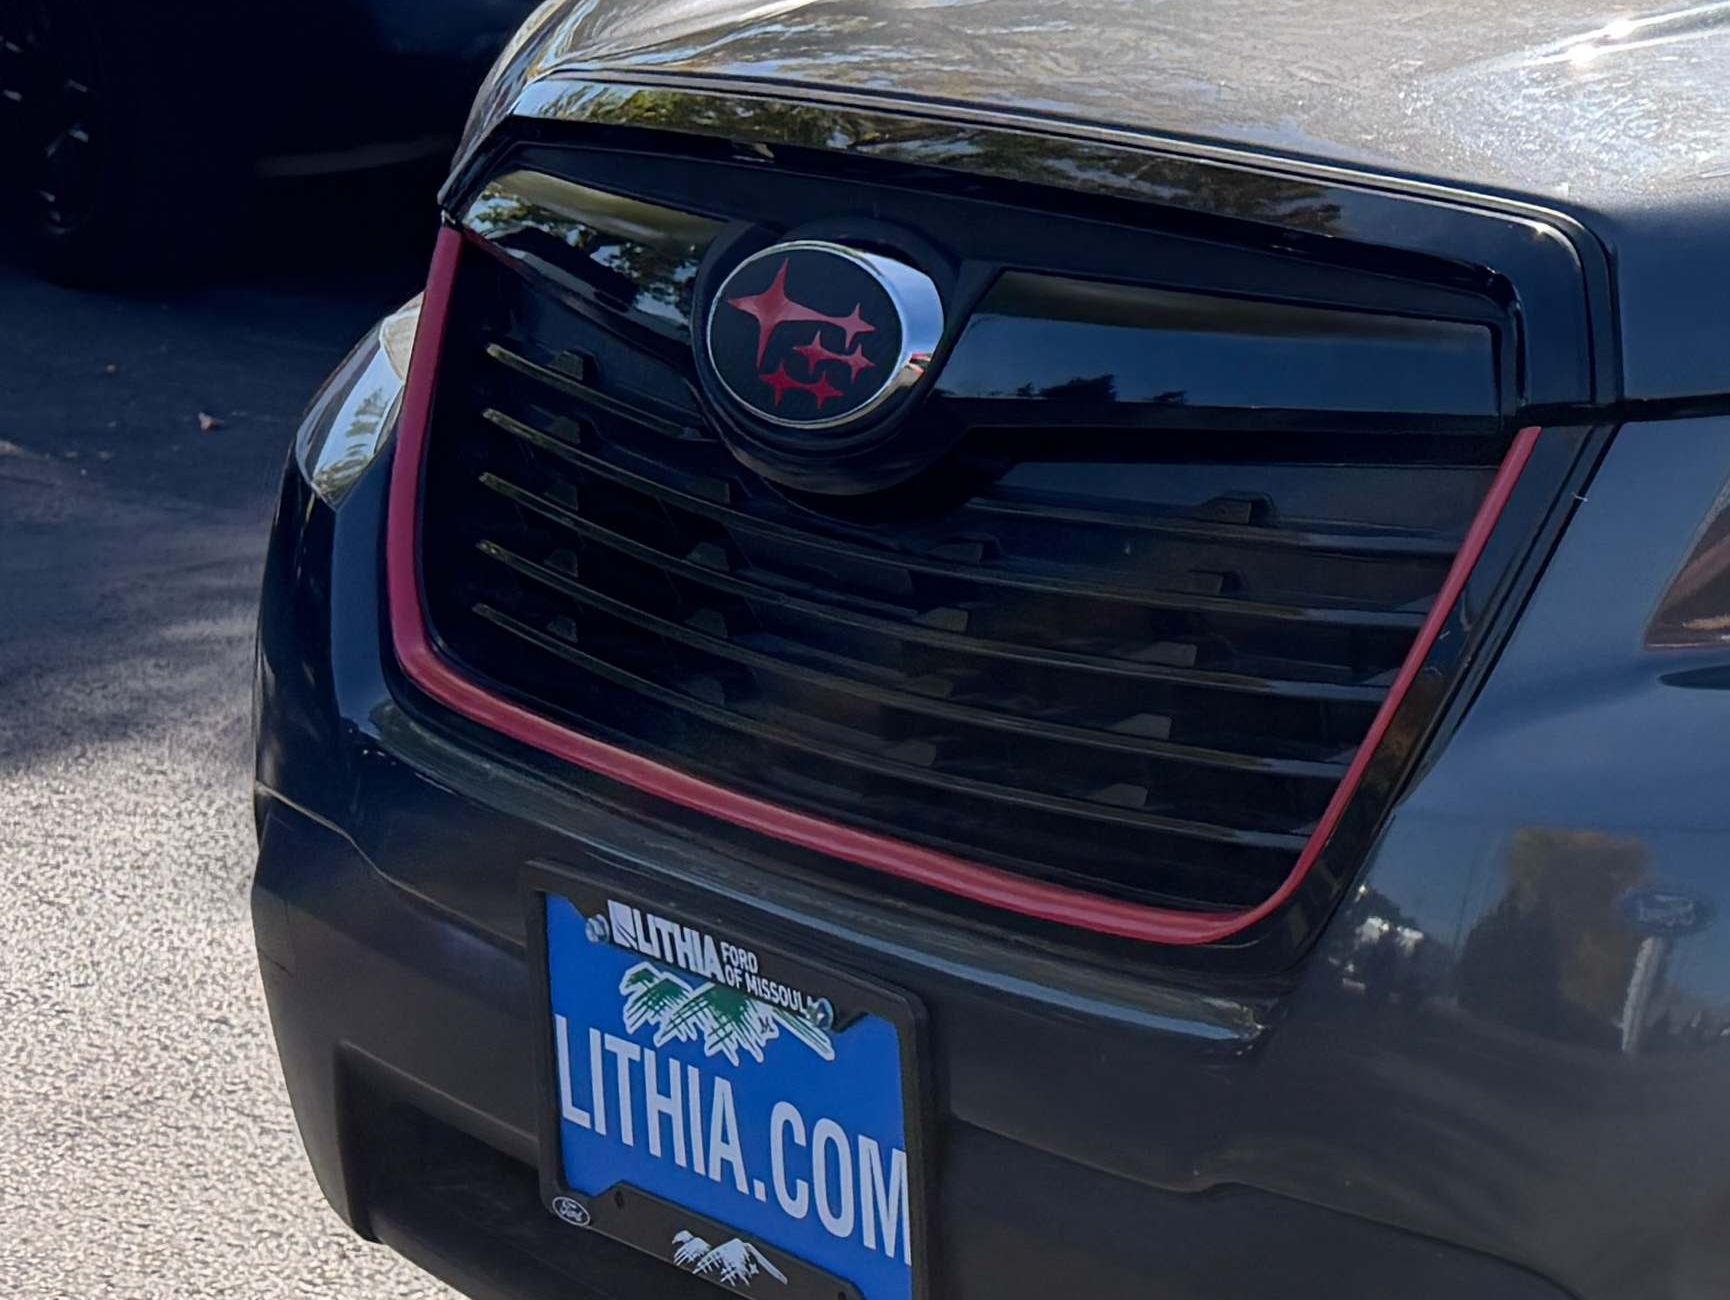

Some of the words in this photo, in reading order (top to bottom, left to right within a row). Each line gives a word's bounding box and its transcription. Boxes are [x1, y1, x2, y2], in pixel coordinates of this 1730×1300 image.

[633, 908, 725, 983] LITHIA
[720, 941, 758, 974] FORD
[724, 965, 743, 988] OF
[555, 1014, 912, 1267] LITHIA.COM
